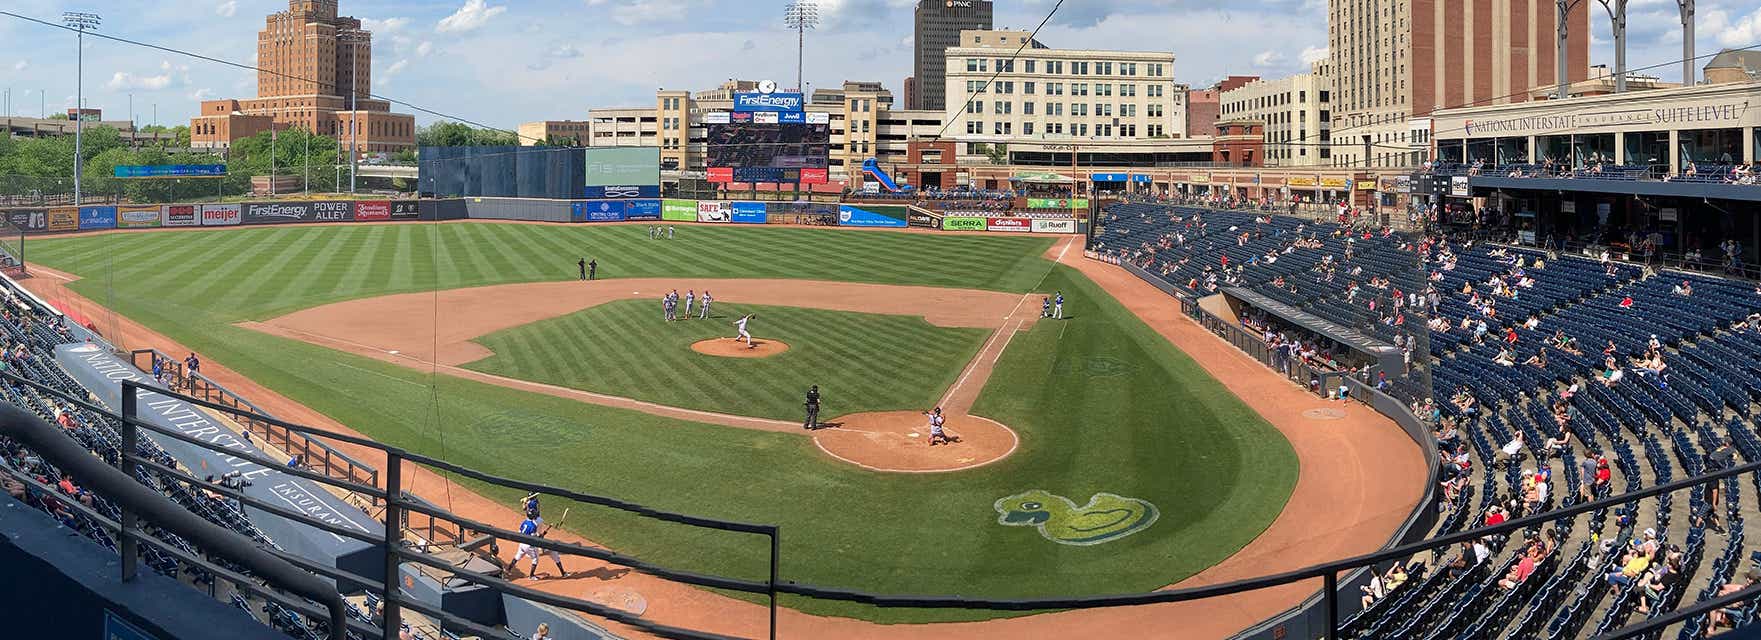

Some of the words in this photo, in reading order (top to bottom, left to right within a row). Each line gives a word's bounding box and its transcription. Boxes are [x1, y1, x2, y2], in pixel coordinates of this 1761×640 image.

[1578, 111, 1652, 124] INSURANCE
[1655, 106, 1694, 124] SUITE
[1696, 103, 1740, 121] LEVEL
[1473, 119, 1516, 133] NATIONAL
[1520, 114, 1577, 130] INTERSTATE
[249, 204, 308, 217] FirstEnergy
[314, 203, 347, 211] POWER
[700, 203, 719, 212] SAFE
[204, 208, 239, 221] meijer
